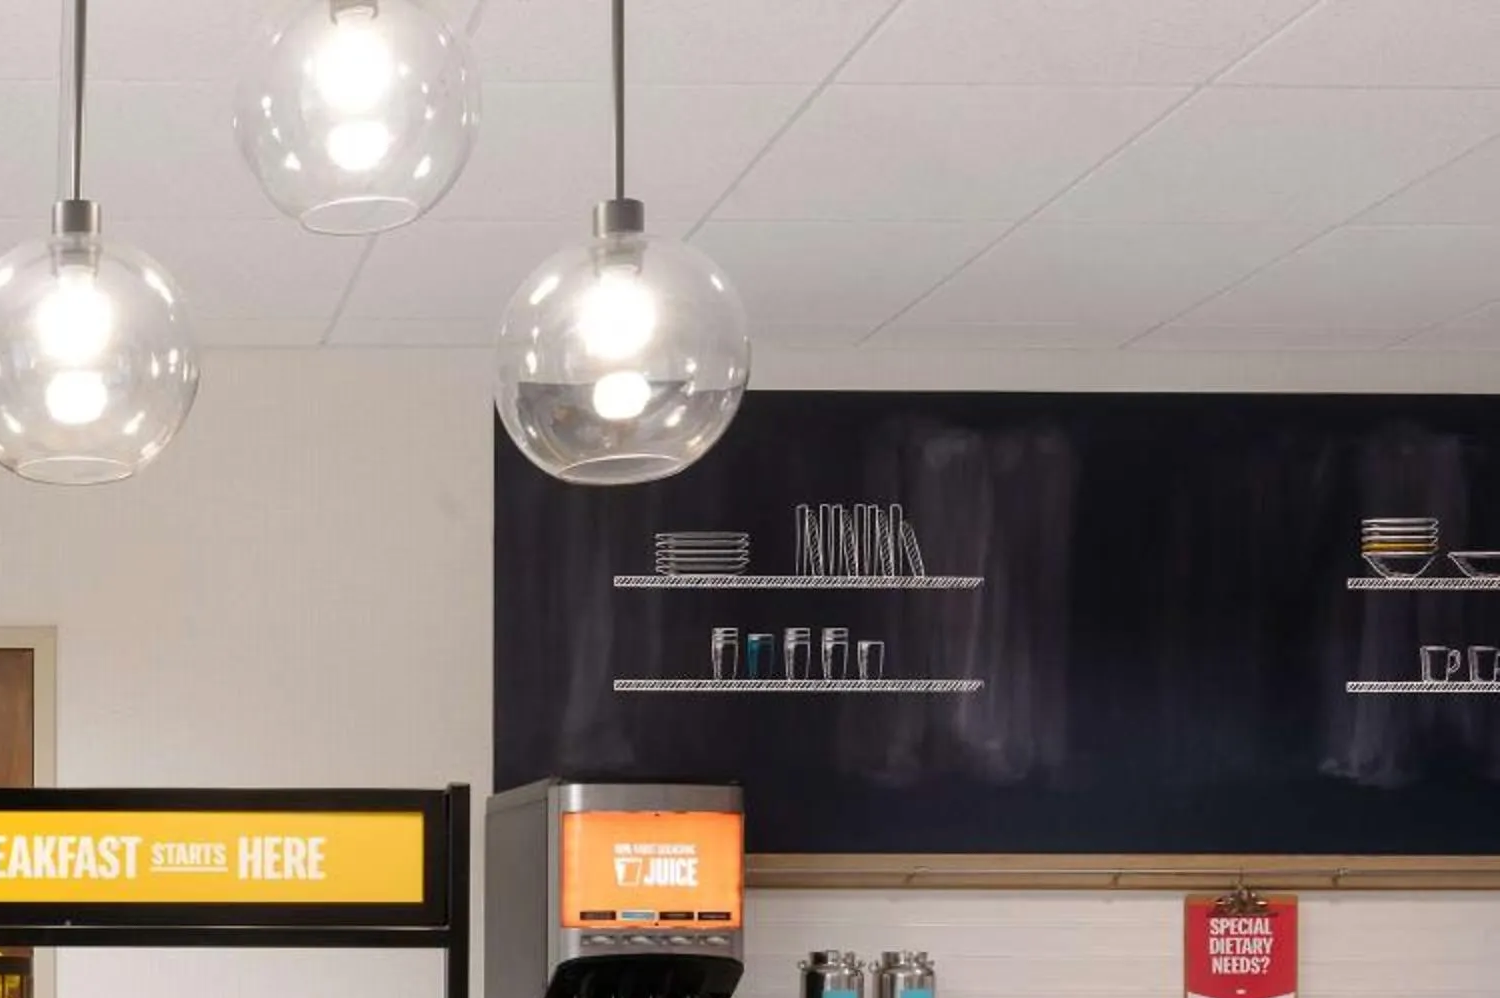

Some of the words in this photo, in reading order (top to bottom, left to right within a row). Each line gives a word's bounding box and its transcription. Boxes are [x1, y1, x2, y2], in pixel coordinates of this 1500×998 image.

[151, 842, 227, 866] STARTS
[237, 835, 326, 880] HERE
[644, 857, 699, 887] JUICE
[1209, 917, 1273, 935] SPECIAL
[1209, 937, 1274, 955] DIETARY
[1211, 956, 1271, 975] NEEDS?
